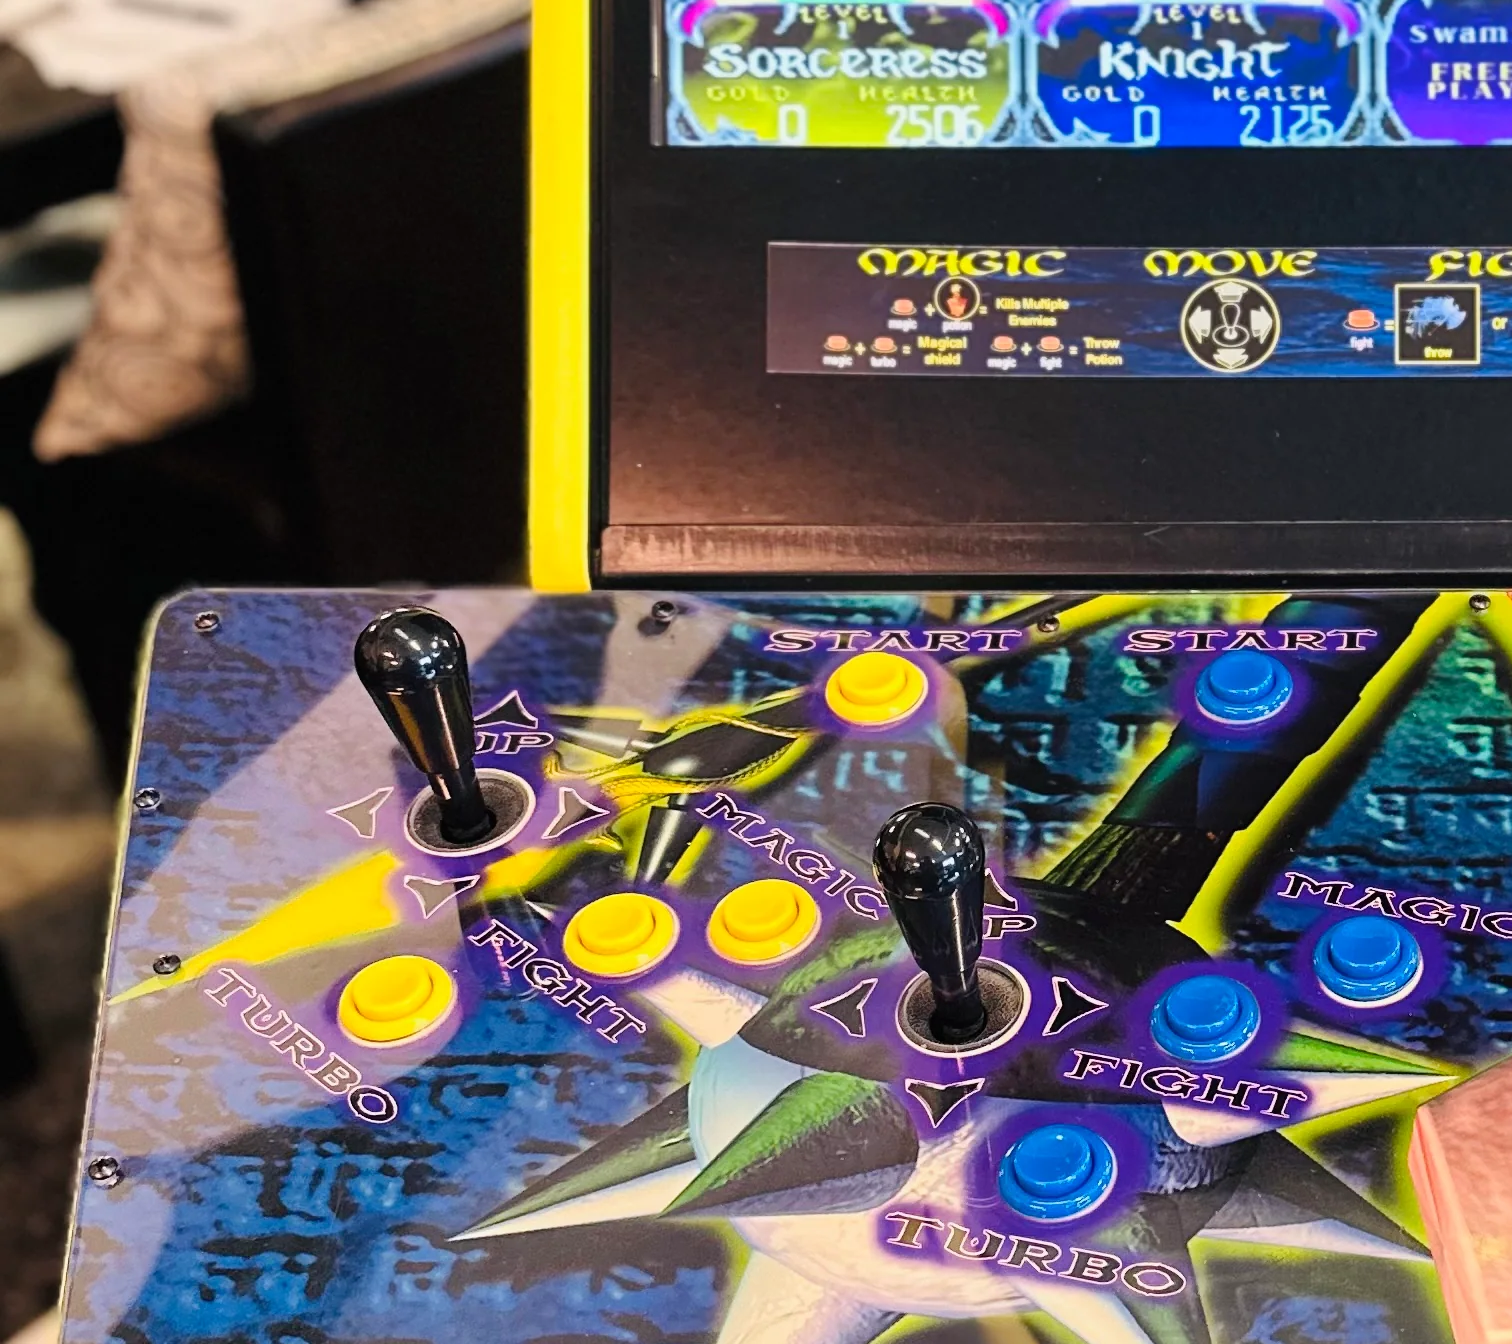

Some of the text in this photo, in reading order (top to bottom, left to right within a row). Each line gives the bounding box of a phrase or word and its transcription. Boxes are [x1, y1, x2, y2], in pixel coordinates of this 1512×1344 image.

[800, 3, 889, 24] LEVEL
[1152, 3, 1243, 24] LEVEL
[706, 84, 978, 103] GOLD HEALTH
[1062, 84, 1328, 102] GOLD HEALTH
[886, 104, 986, 146] 2506
[857, 247, 1068, 277] MAGIC
[1143, 249, 1319, 278] MOVE
[995, 297, 1070, 313] Kills Multiple
[917, 336, 968, 351] Magical
[763, 629, 1023, 652] START
[1124, 628, 1377, 652] START
[695, 790, 890, 921] MAGIC
[982, 914, 1038, 940] P
[467, 917, 648, 1044] FIGHT
[203, 967, 400, 1125] TURBO
[1065, 1049, 1308, 1119] FIGHT
[885, 1212, 1188, 1299] TURBO
